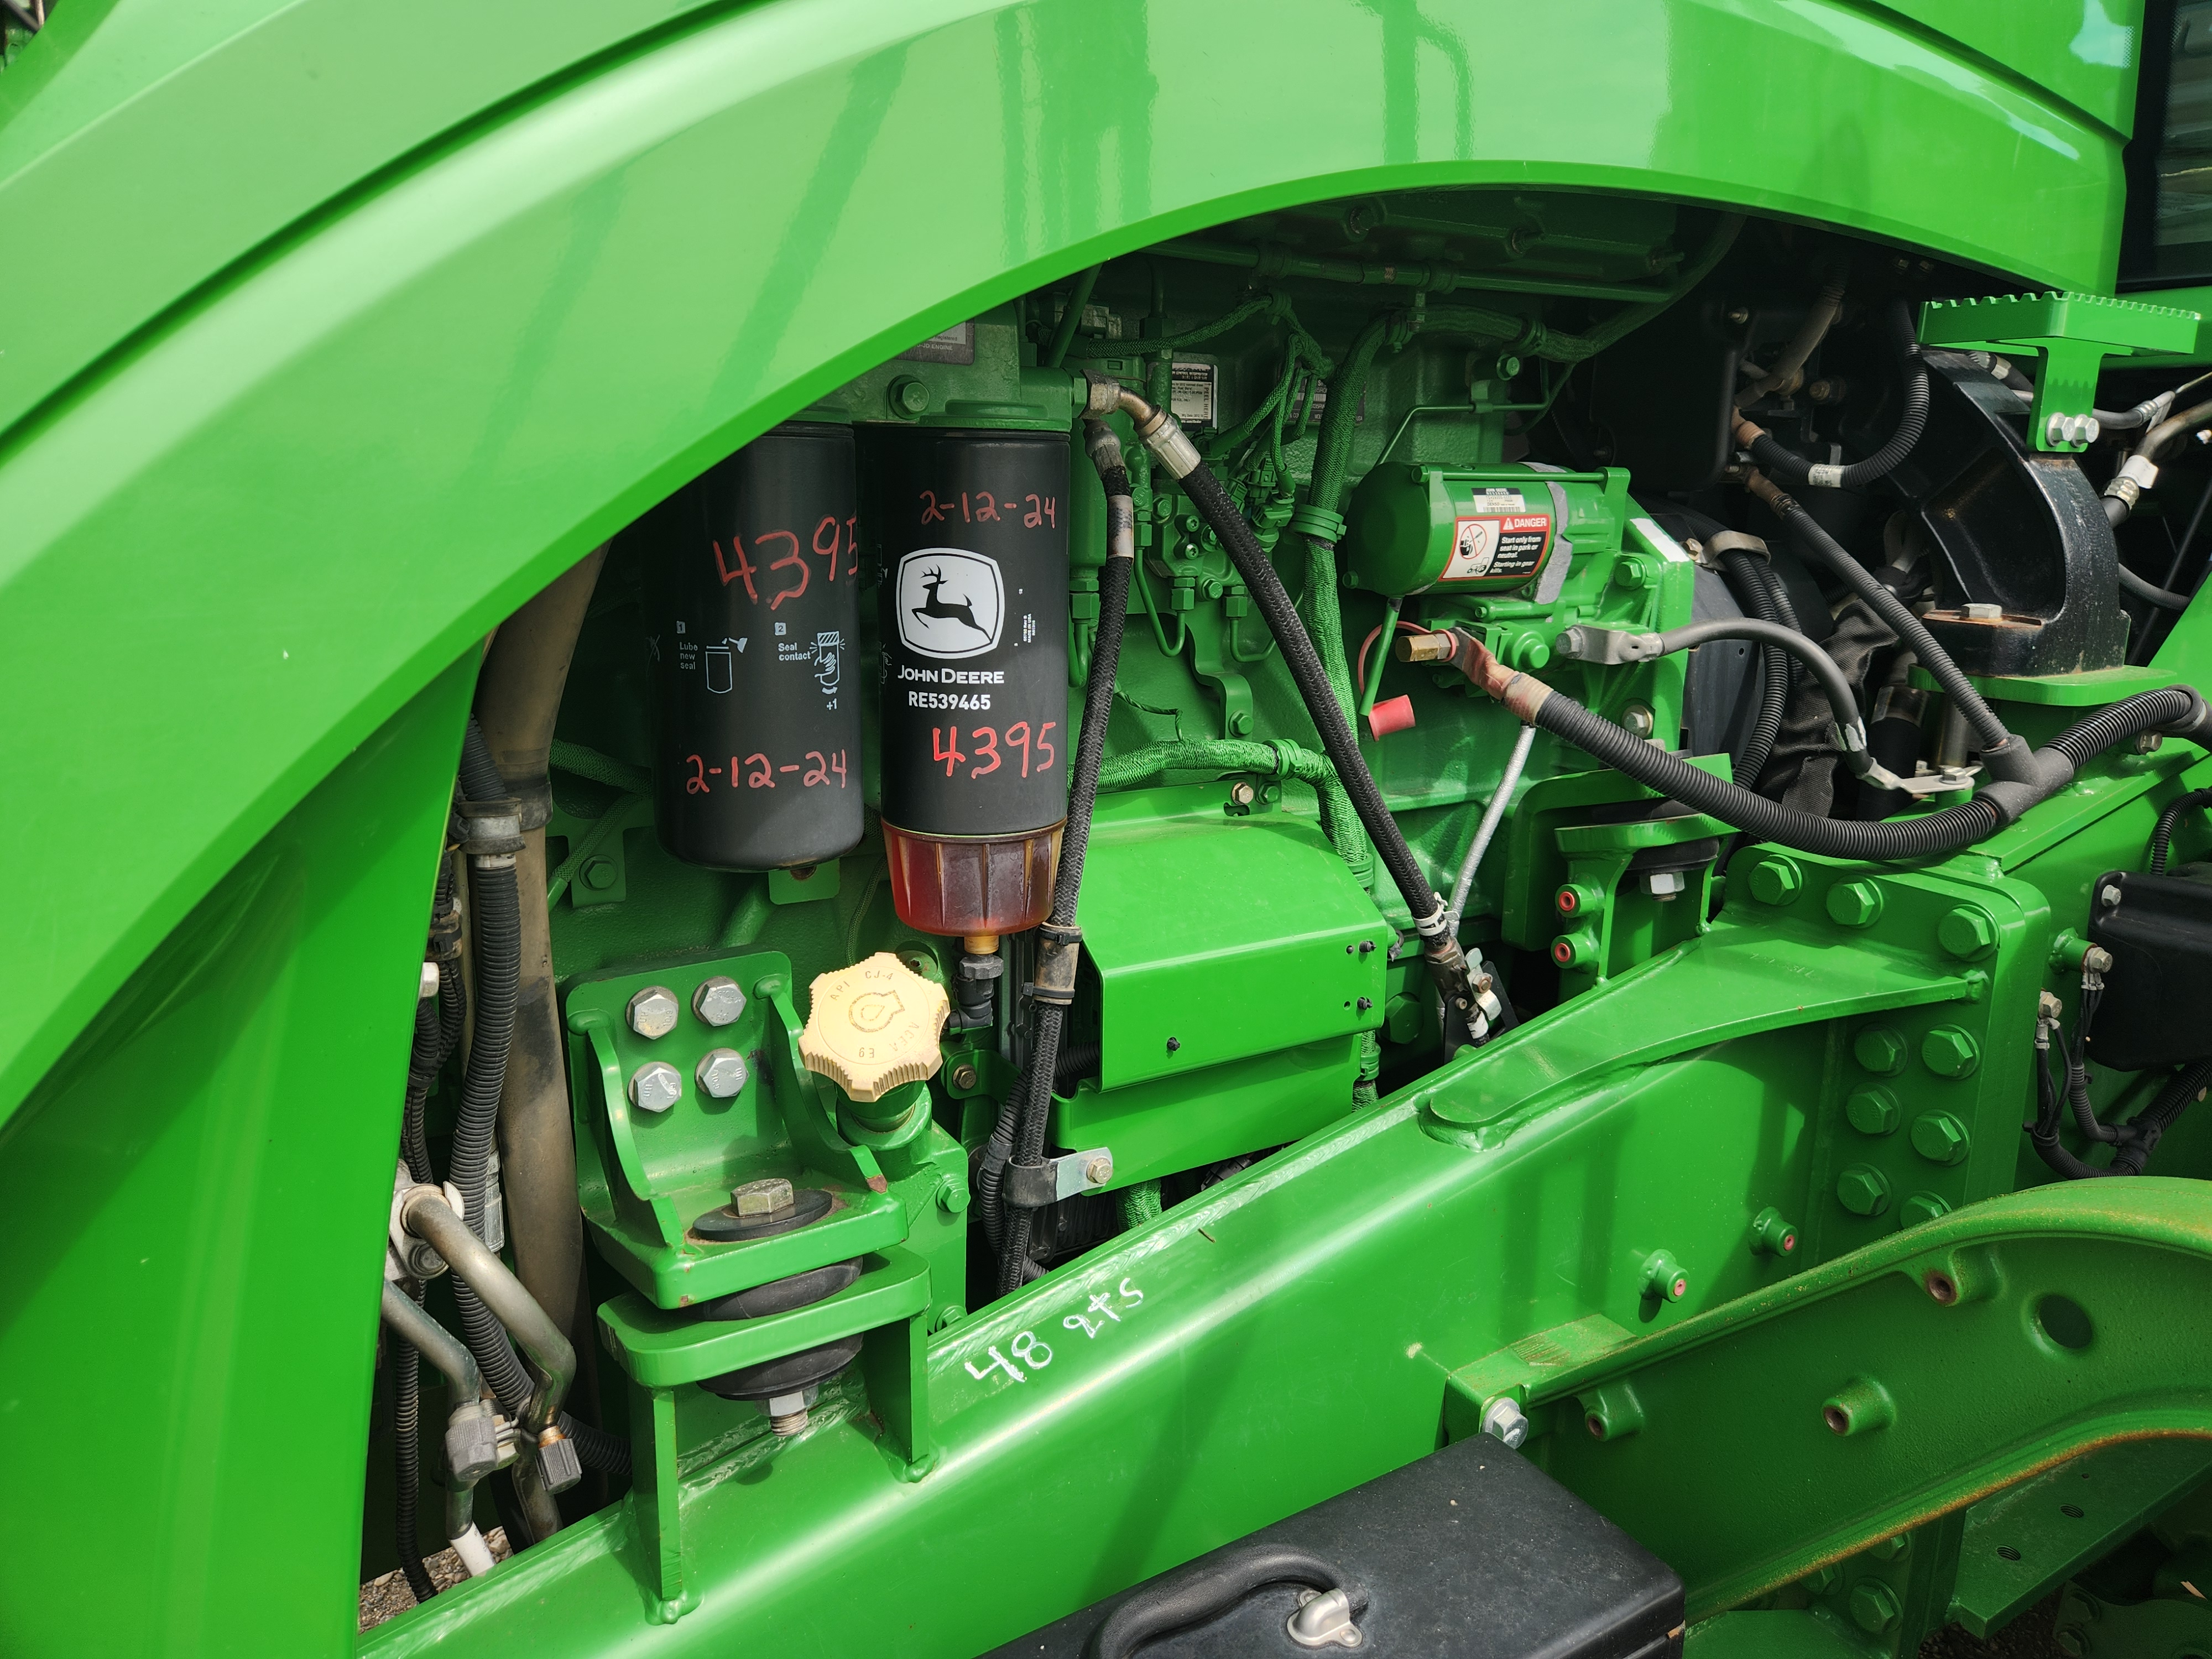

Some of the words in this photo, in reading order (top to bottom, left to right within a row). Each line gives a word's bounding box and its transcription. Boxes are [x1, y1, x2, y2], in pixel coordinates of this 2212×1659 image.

[920, 490, 1056, 529] 2-12-24
[1514, 518, 1547, 528] DANGER
[1515, 536, 1528, 544] only
[1517, 544, 1531, 552] park
[680, 641, 698, 651] Lube
[778, 642, 797, 651] Seal
[779, 650, 811, 661] contact
[680, 661, 696, 670] seal
[898, 665, 938, 683] JOHN
[941, 668, 1005, 685] DEERE
[826, 698, 837, 711] +1
[909, 691, 991, 711] RE539465
[932, 721, 1057, 780] 4395
[686, 749, 848, 794] 2-12-24
[830, 980, 851, 1001] API
[865, 970, 894, 980] CJ-4
[663, 1008, 673, 1026] 10.9
[889, 1021, 920, 1052] ACEA
[964, 1331, 1053, 1383] 48
